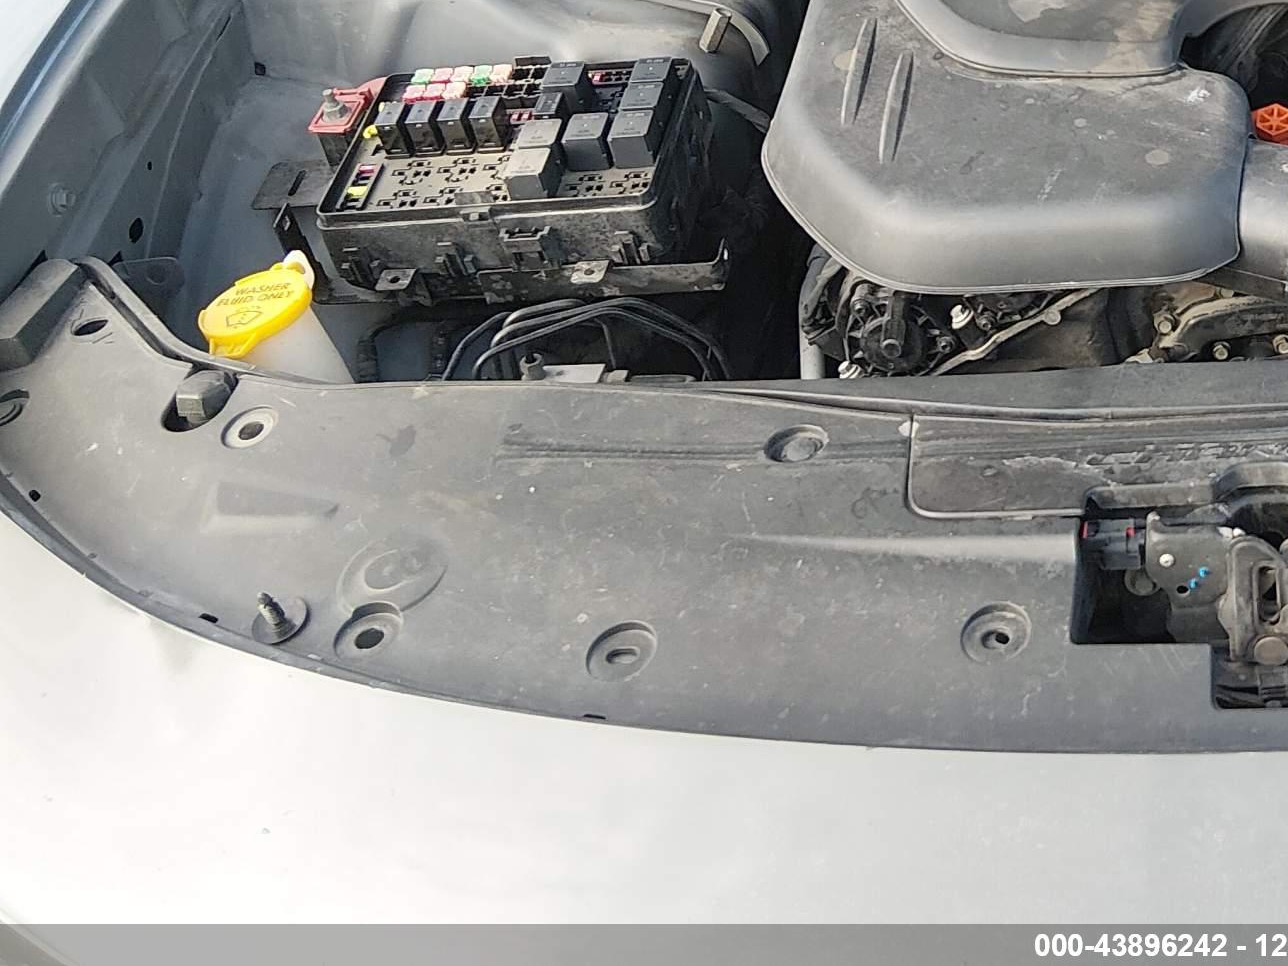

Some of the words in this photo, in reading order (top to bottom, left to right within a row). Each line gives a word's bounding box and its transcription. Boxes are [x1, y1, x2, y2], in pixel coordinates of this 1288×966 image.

[236, 282, 291, 295] WASHER
[216, 295, 255, 306] FLUID
[257, 290, 295, 302] ONLY
